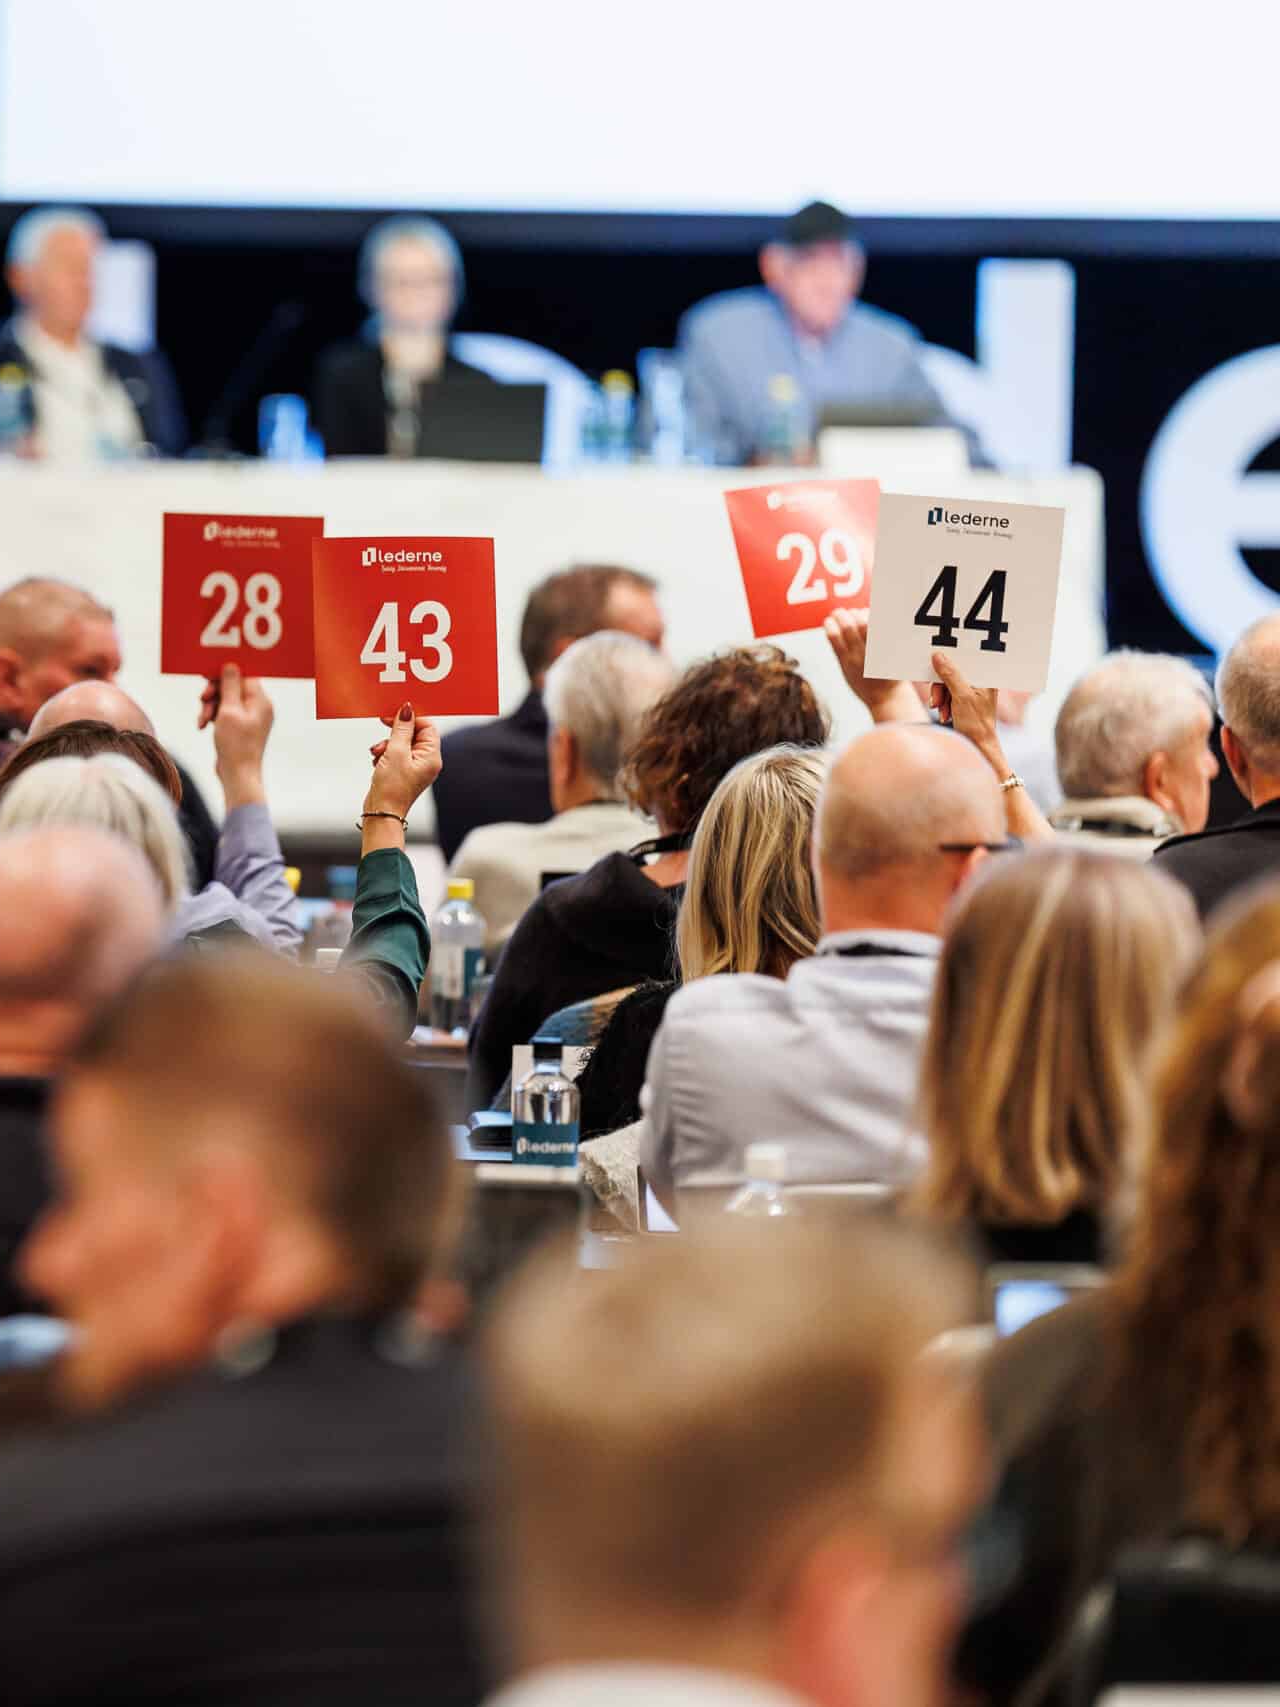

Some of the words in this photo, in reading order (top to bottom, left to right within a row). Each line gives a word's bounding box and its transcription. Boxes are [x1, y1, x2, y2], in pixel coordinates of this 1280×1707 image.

[378, 549, 442, 563] lederne
[944, 510, 1010, 528] lederne
[776, 527, 865, 605] 29
[199, 571, 283, 649] 28
[360, 600, 454, 683] 43
[914, 565, 1009, 652] 44
